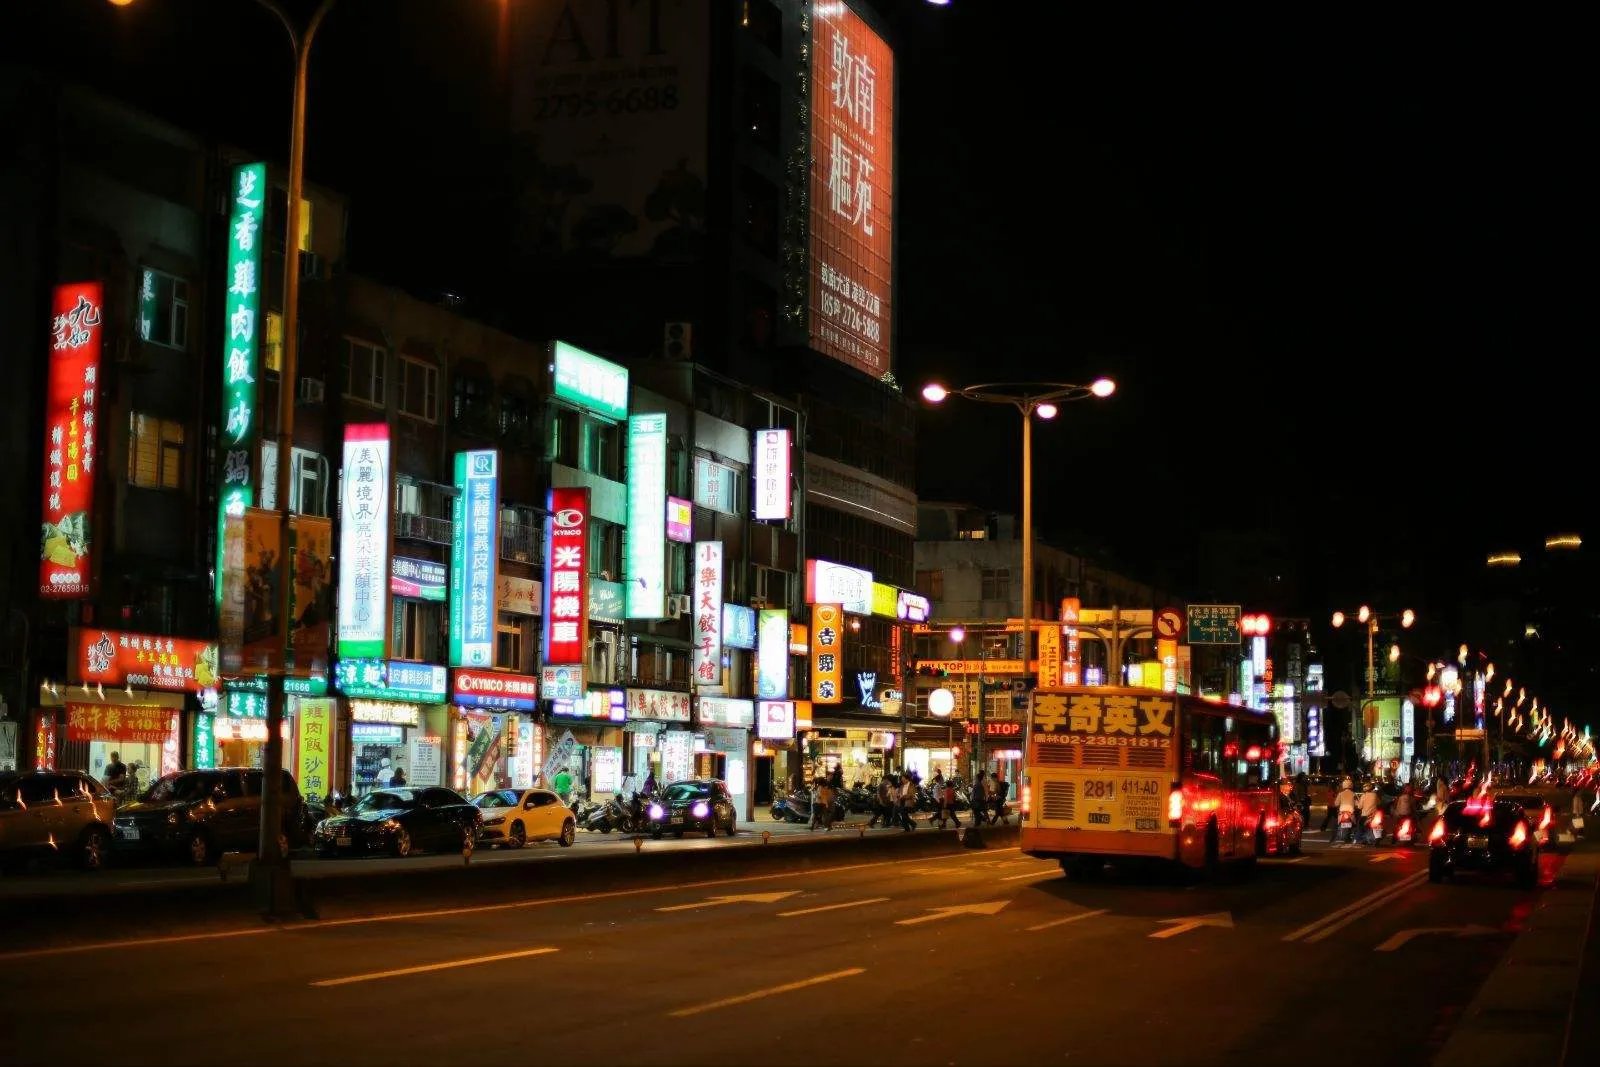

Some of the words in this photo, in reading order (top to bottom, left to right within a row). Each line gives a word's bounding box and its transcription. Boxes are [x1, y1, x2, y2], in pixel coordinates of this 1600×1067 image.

[831, 29, 876, 135] 敦南
[552, 546, 581, 642] 光陽機車
[697, 544, 717, 681] 小樂天餃子館
[471, 677, 503, 692] KYMCO
[505, 681, 535, 695] 光陽機車
[627, 691, 689, 718] 小樂天餃子館
[1033, 694, 1175, 736] 李奇英文
[966, 723, 1020, 735] HILTOP
[1083, 779, 1115, 798] 281
[1121, 779, 1159, 795] 411-AD
